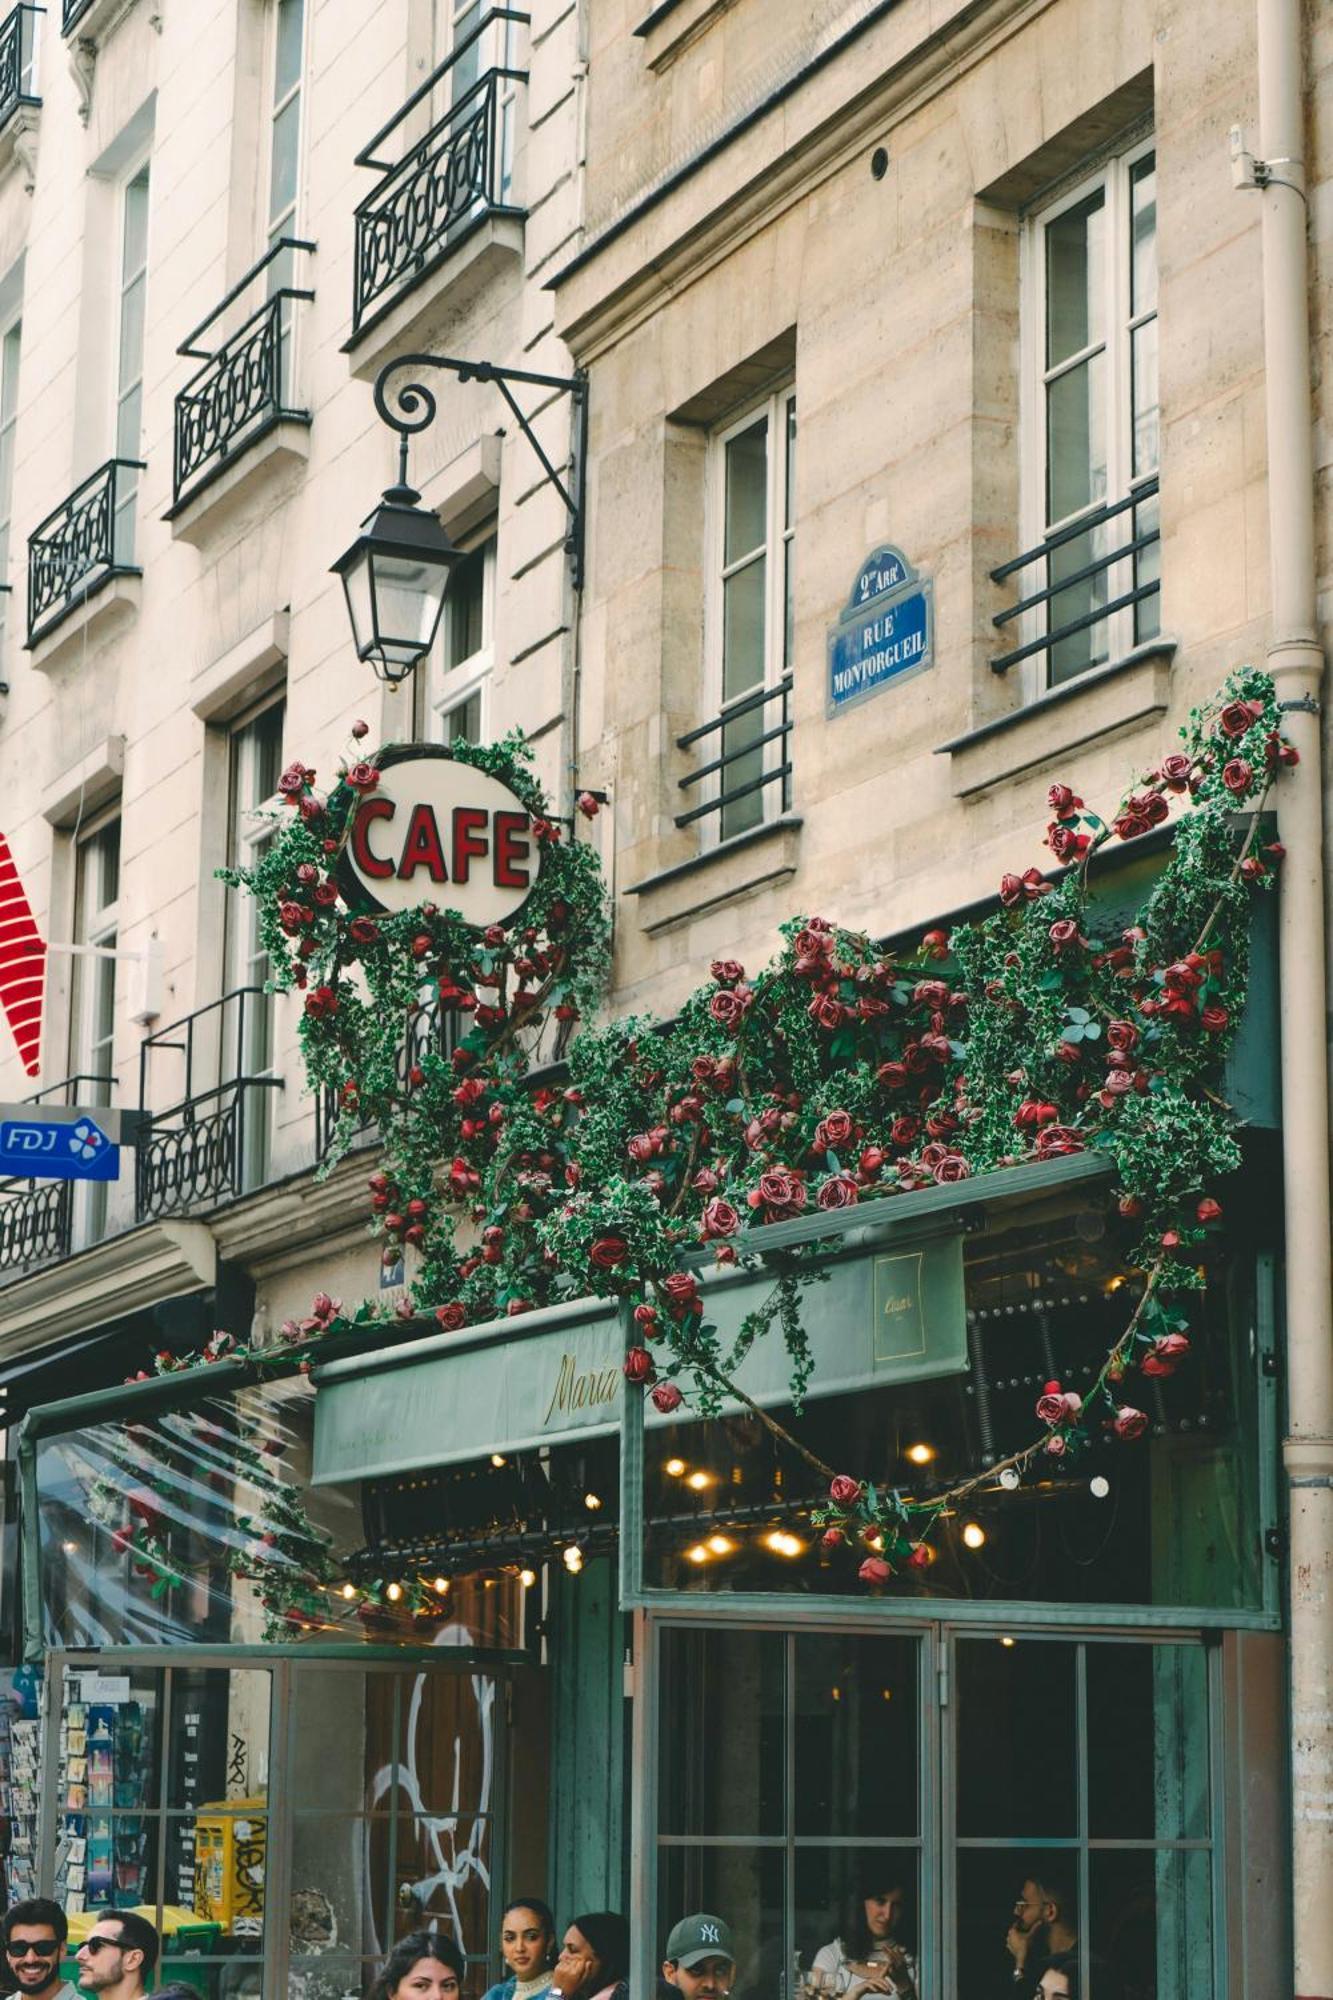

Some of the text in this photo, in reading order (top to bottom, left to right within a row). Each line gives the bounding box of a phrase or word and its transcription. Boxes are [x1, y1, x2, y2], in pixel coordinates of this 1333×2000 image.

[863, 615, 894, 650] RUE
[833, 630, 926, 695] MONTORGUEIL
[350, 797, 530, 889] CAFE
[6, 1128, 58, 1151] FDJ
